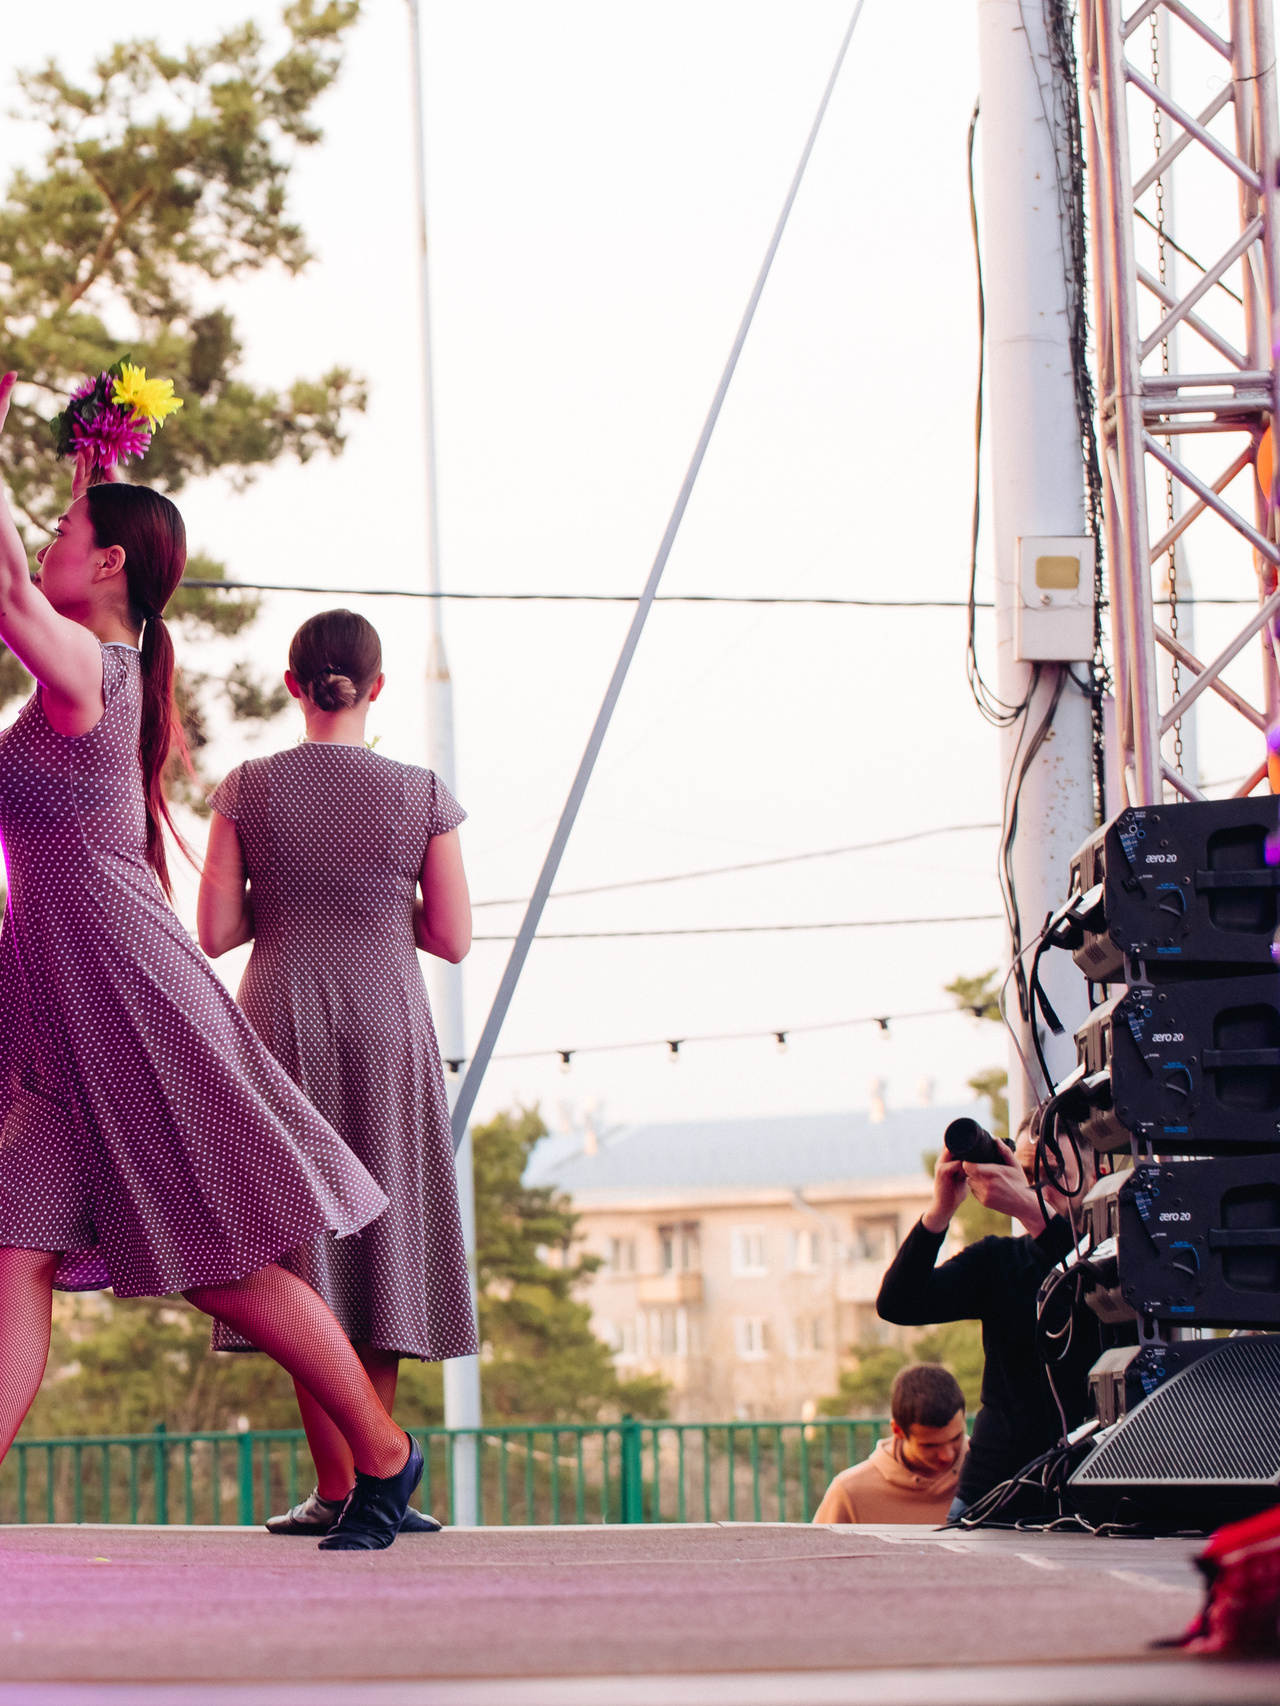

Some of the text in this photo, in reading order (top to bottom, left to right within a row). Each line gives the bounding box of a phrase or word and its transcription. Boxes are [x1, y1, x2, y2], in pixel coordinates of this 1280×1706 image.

[1145, 854, 1177, 863] aero 20
[1152, 1033, 1184, 1042] aero 20
[1159, 1212, 1191, 1222] aero 20
